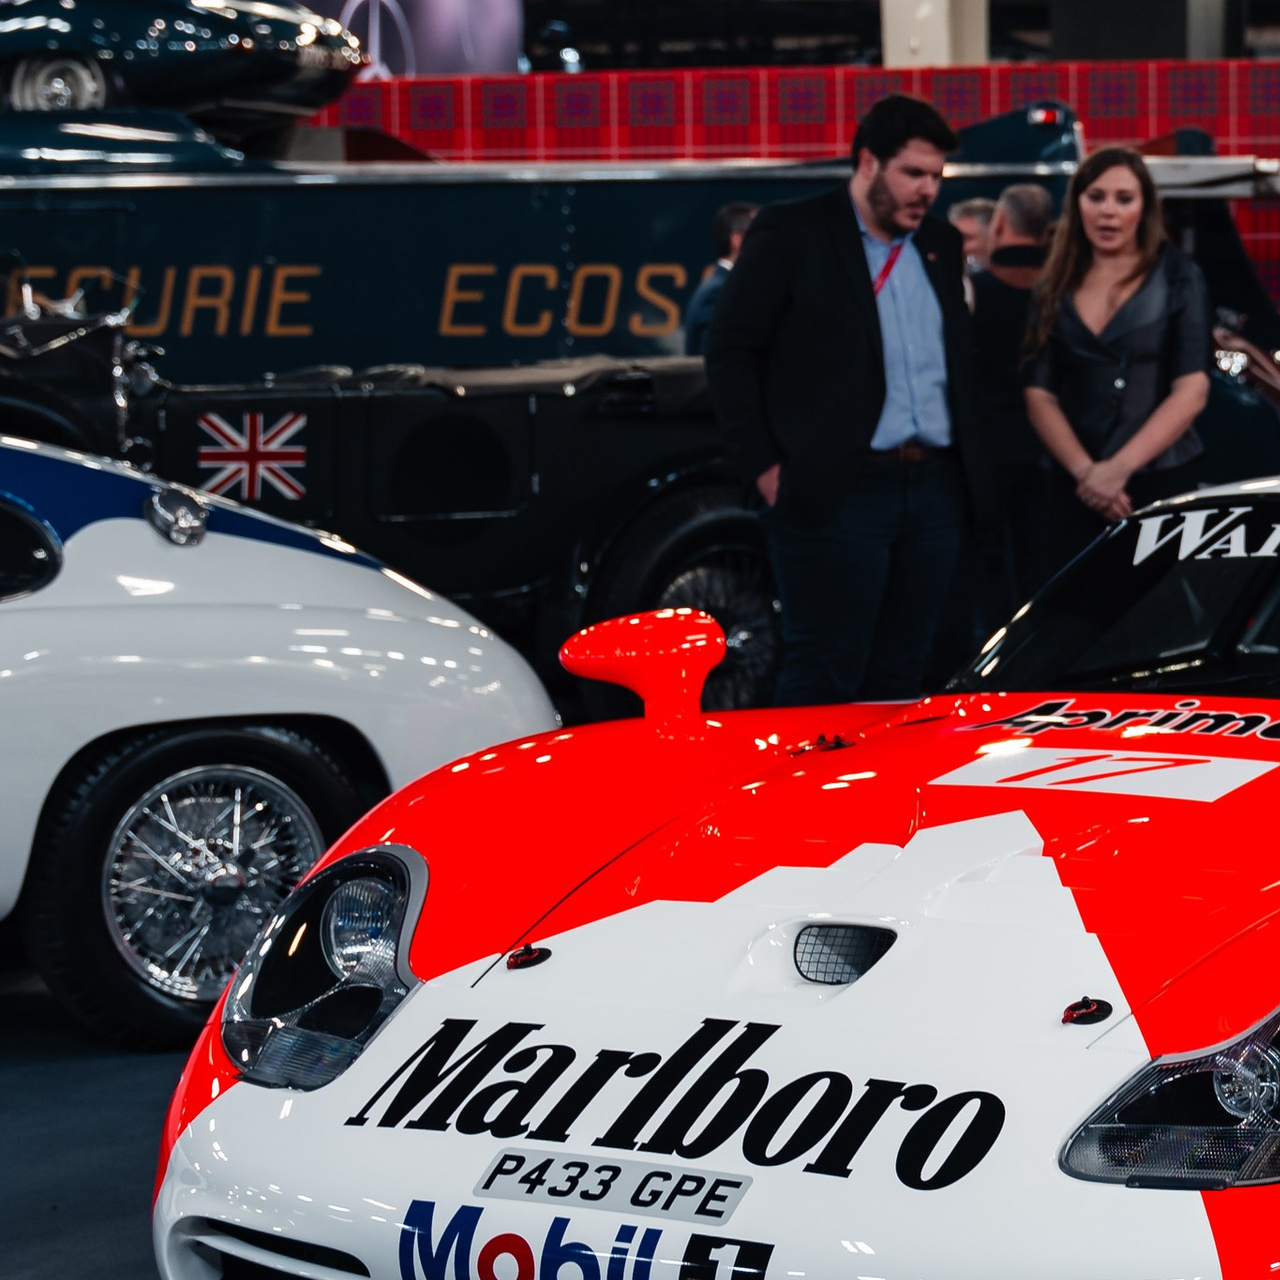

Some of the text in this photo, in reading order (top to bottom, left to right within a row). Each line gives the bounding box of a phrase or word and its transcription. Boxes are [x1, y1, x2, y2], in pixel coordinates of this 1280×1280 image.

[438, 264, 716, 337] ECOS
[994, 753, 1213, 786] 17
[344, 1017, 1006, 1191] Marlboro
[481, 1153, 744, 1219] P433 GPE
